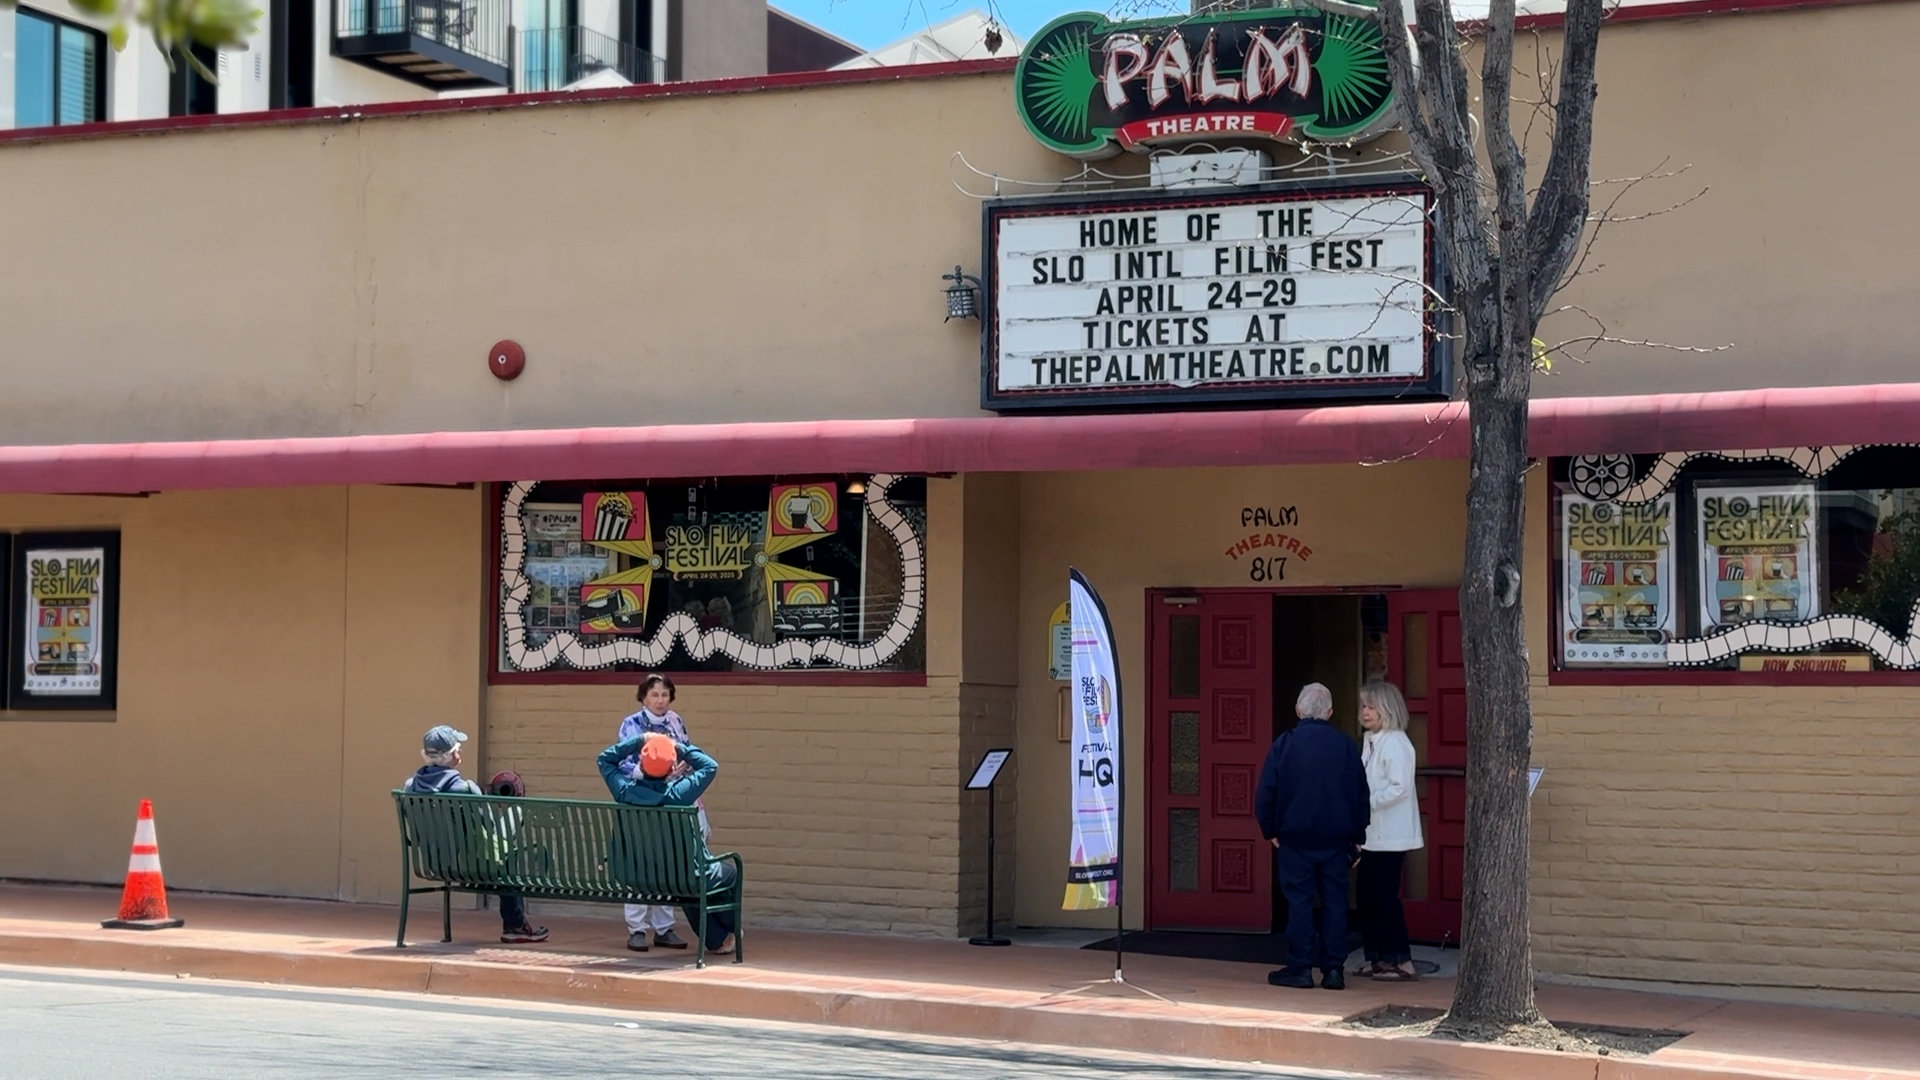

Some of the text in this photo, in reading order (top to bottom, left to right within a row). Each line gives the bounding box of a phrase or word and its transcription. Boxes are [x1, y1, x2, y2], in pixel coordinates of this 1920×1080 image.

[1102, 23, 1312, 111] PALM
[1147, 115, 1256, 137] THEATRE
[1080, 207, 1313, 248] HOME OF THE
[1032, 239, 1384, 285] SLO INTL FILM FEST
[1096, 278, 1297, 316] APRIL 24-29
[1083, 314, 1286, 349] TICKETS AT
[1031, 345, 1390, 385] THEPALMTHEATRE.COM
[1241, 506, 1298, 527] PALM
[666, 525, 750, 547] SLO FILM
[1568, 525, 1671, 546] FESTIVAL
[1703, 519, 1810, 541] FESTIVAL
[666, 545, 751, 567] FESTIVAL
[1225, 533, 1313, 561] THEATRE
[1250, 557, 1287, 581] 817
[31, 577, 99, 594] FESTIVAL
[1761, 659, 1847, 672] NOW SHOWING
[1078, 757, 1114, 788] HQ
